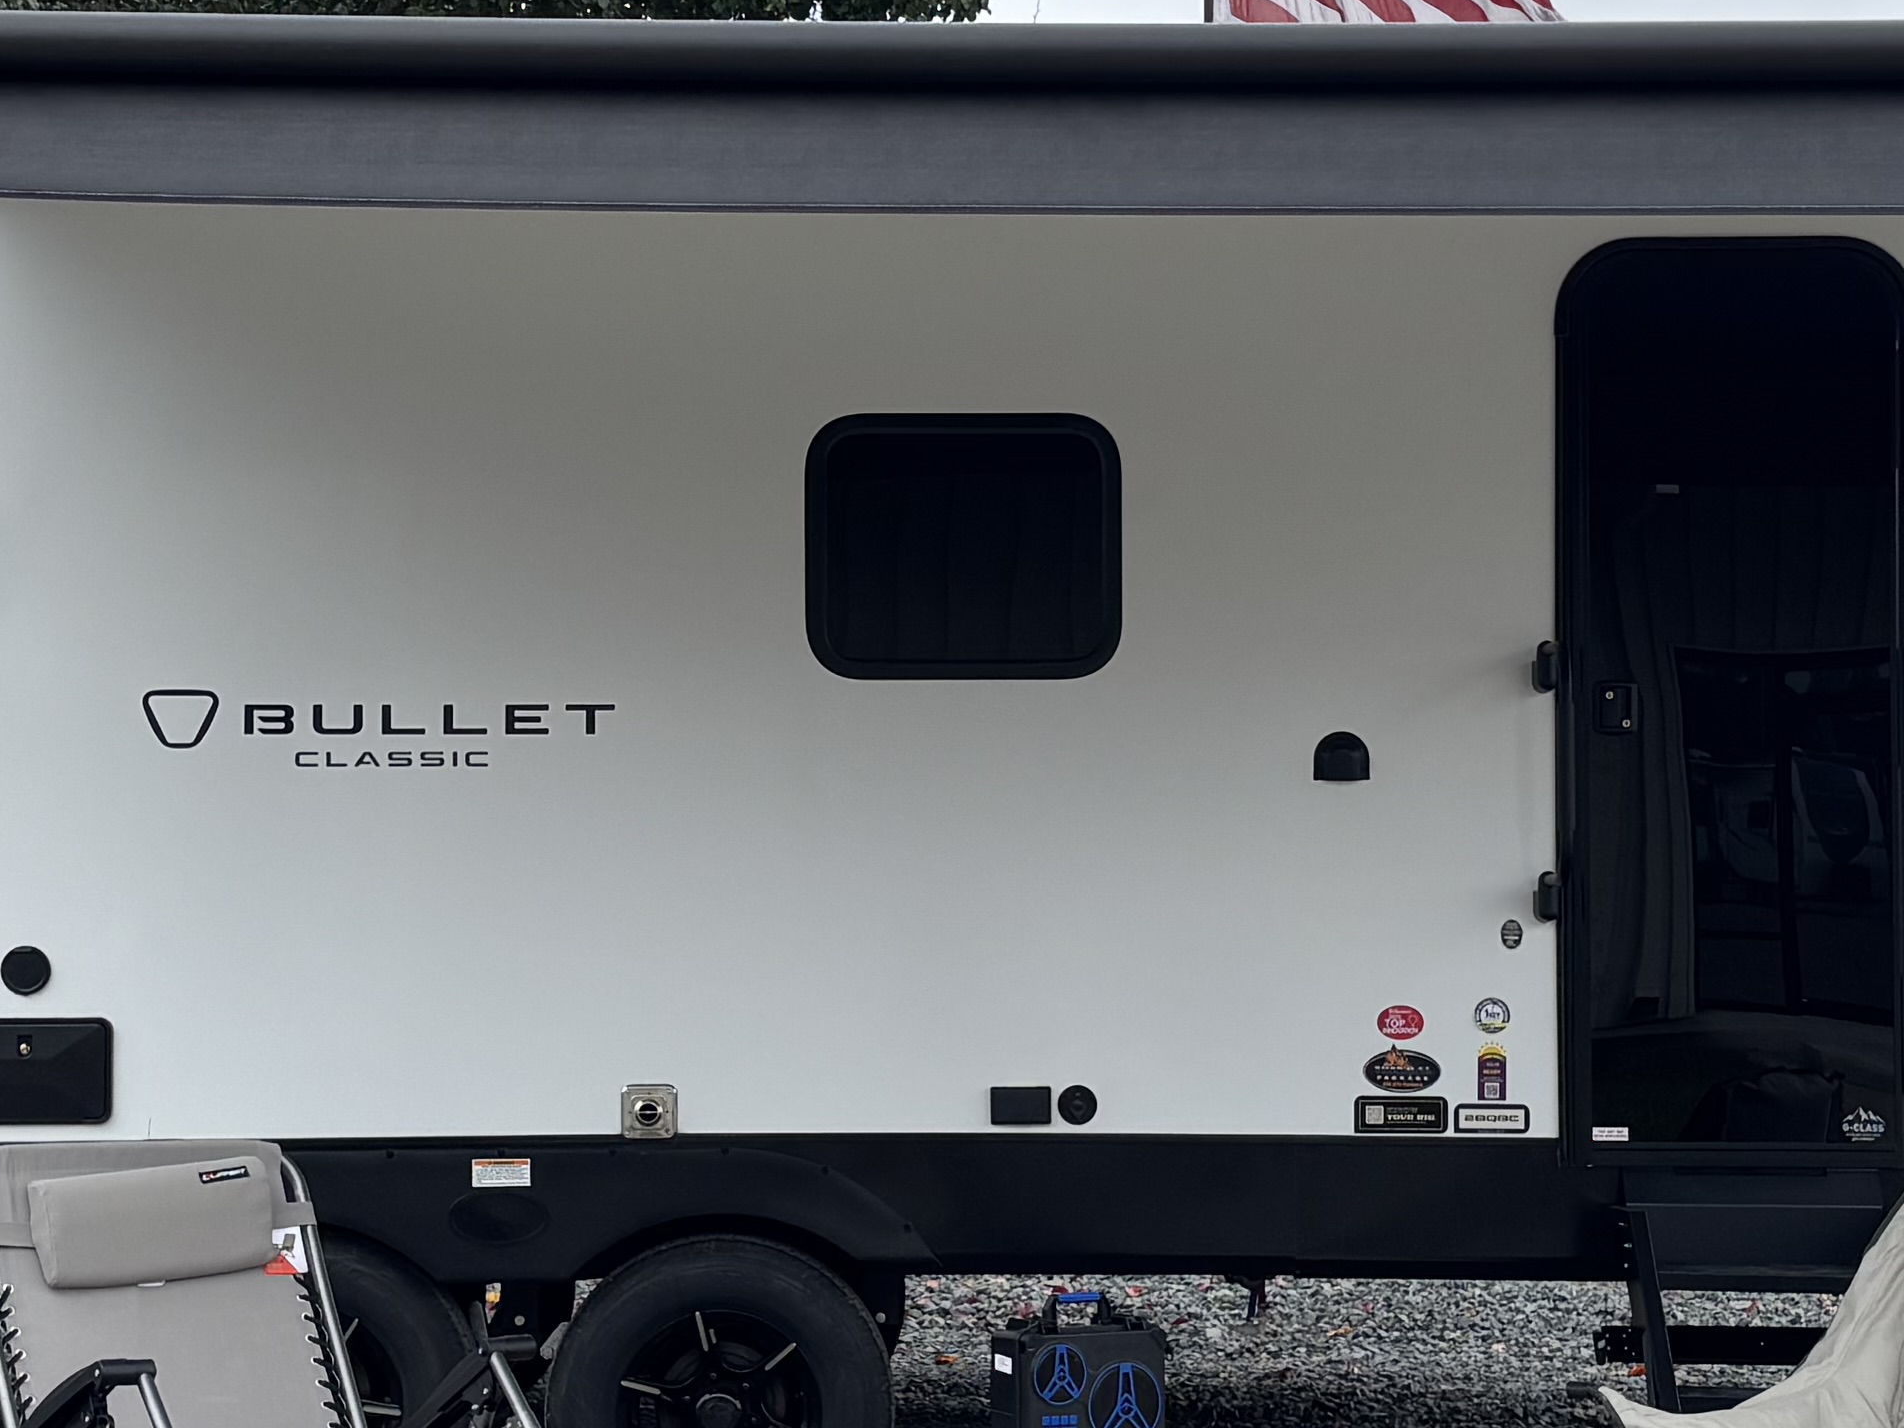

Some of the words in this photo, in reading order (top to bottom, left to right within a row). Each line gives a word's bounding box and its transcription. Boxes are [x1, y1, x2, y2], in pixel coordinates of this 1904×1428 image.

[243, 703, 616, 736] BULLET
[294, 751, 489, 768] CLASSIC
[1384, 1018, 1407, 1029] TOP
[1841, 1122, 1885, 1133] G-CLASS
